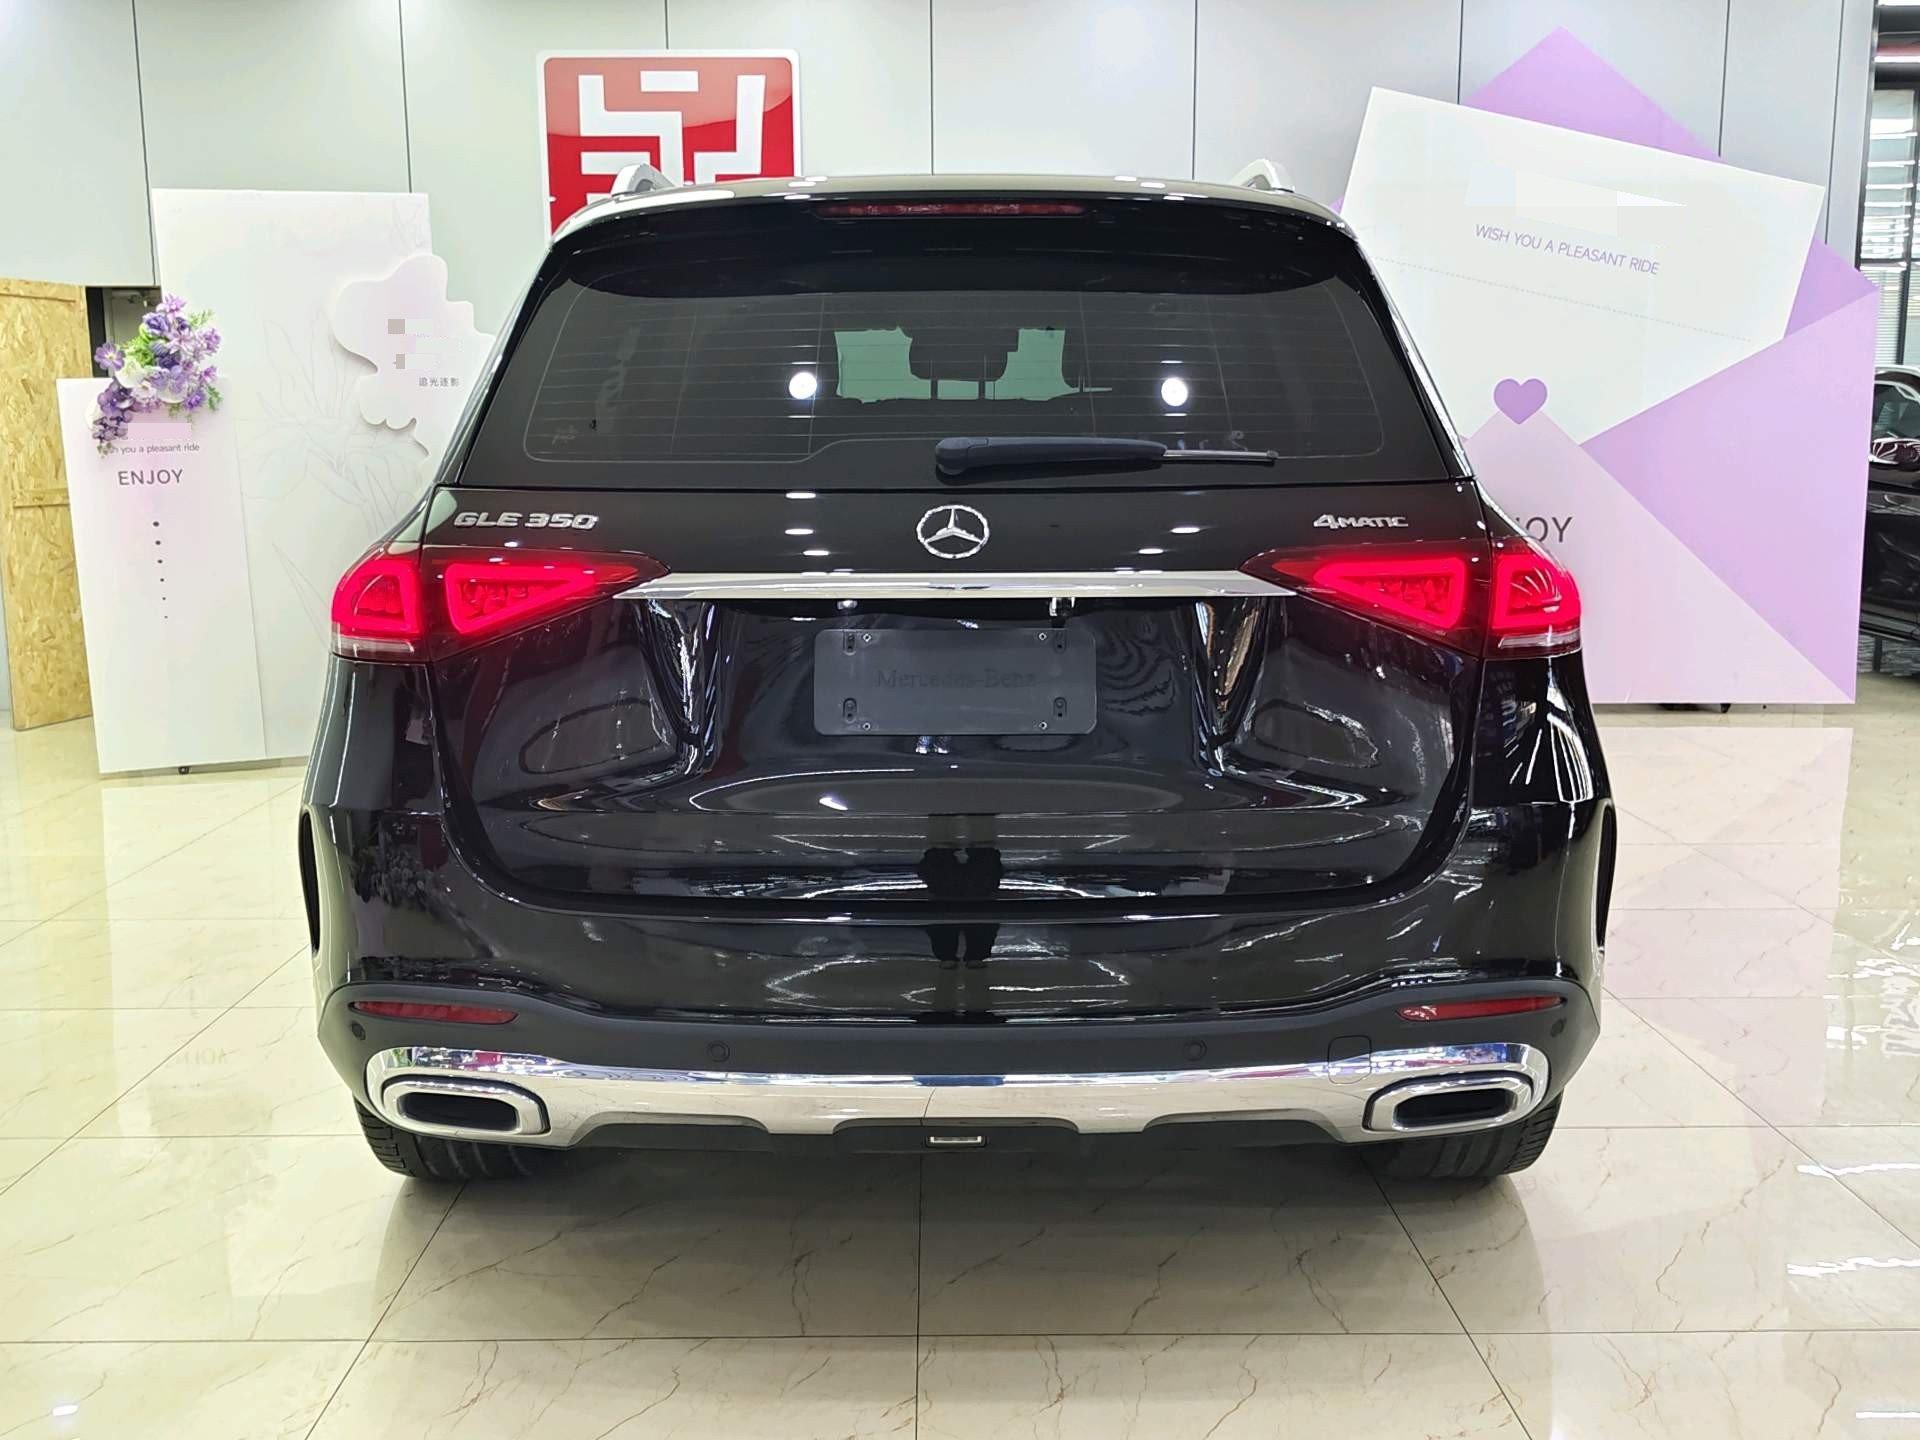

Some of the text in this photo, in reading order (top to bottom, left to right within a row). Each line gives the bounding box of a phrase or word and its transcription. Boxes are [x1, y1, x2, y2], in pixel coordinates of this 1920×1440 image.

[1475, 224, 1660, 275] WISH YOU A PLEASANT RIDE
[121, 447, 136, 455] you
[146, 444, 181, 454] pleasant
[184, 443, 200, 452] ride
[118, 469, 183, 485] ENJOY
[454, 511, 599, 530] GLE 350
[1313, 514, 1408, 529] 4MATIC
